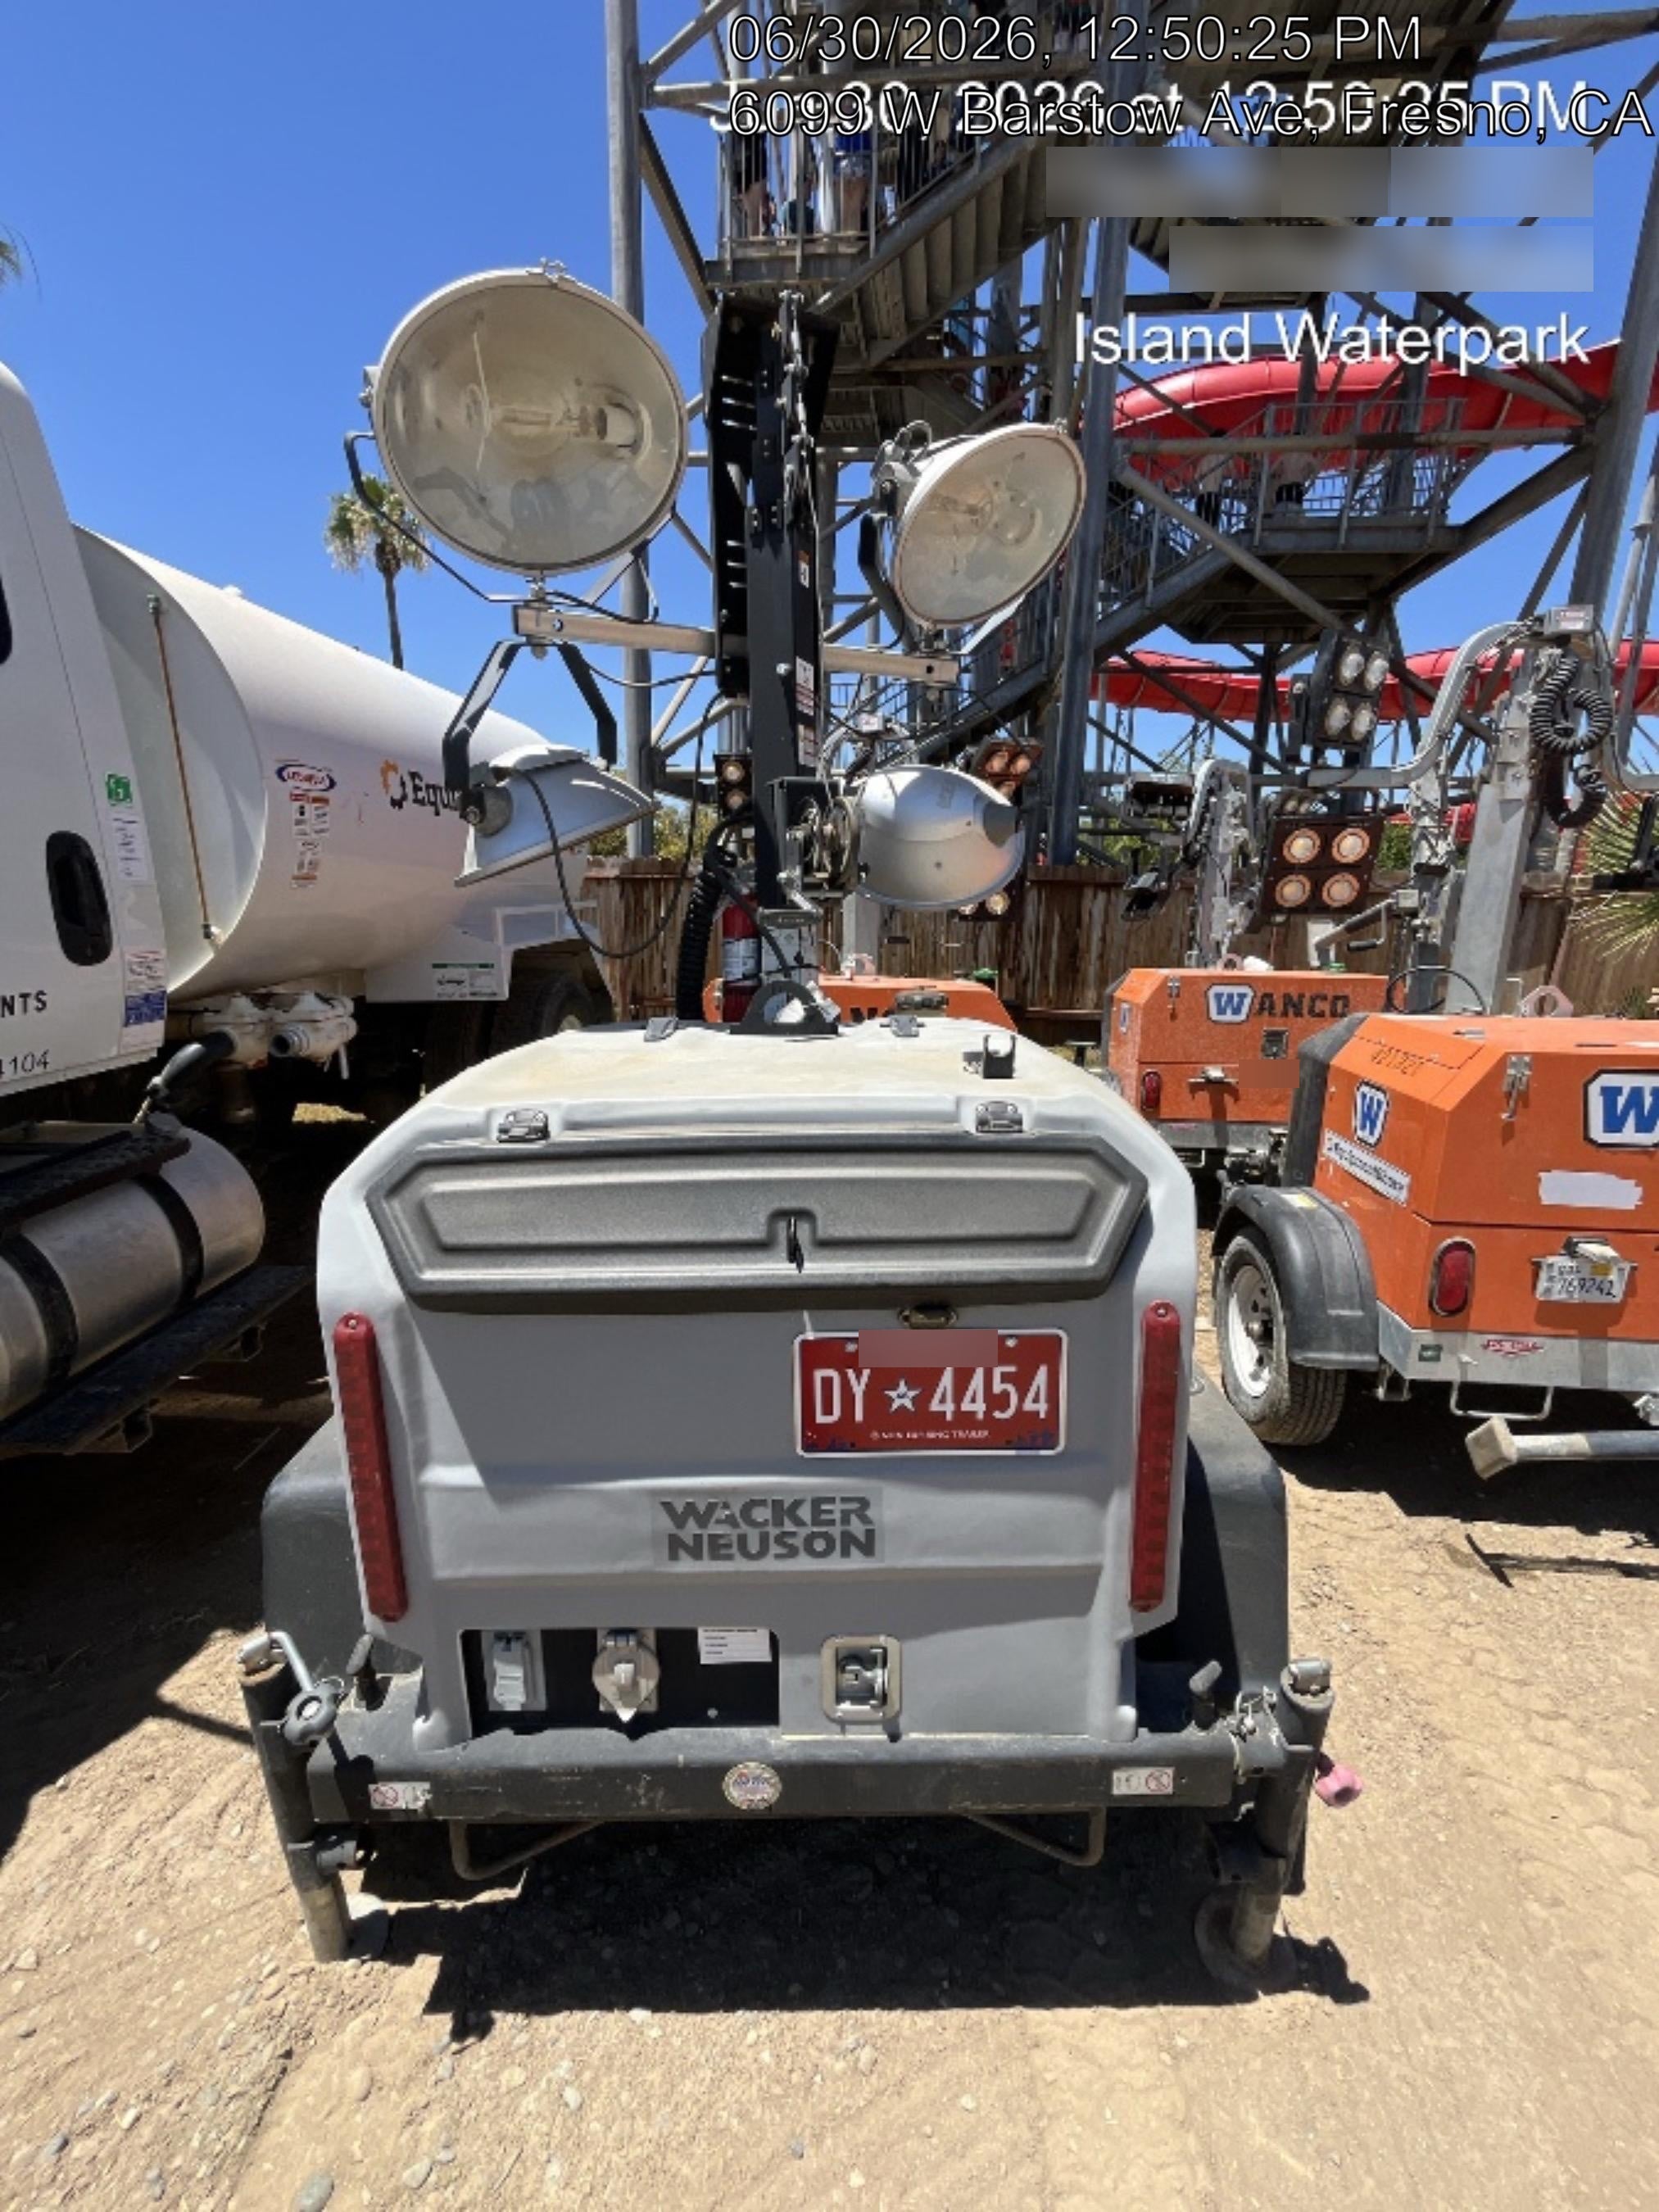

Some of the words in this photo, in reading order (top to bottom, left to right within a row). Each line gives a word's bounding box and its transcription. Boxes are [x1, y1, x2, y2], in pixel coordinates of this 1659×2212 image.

[0, 990, 48, 1018] NTS
[1213, 992, 1350, 1018] WANCO
[1358, 1090, 1385, 1136] W
[813, 1367, 871, 1425] DY
[928, 1363, 1049, 1421] 4454
[659, 1496, 876, 1530] WACKER
[667, 1528, 876, 1562] NEUSON
